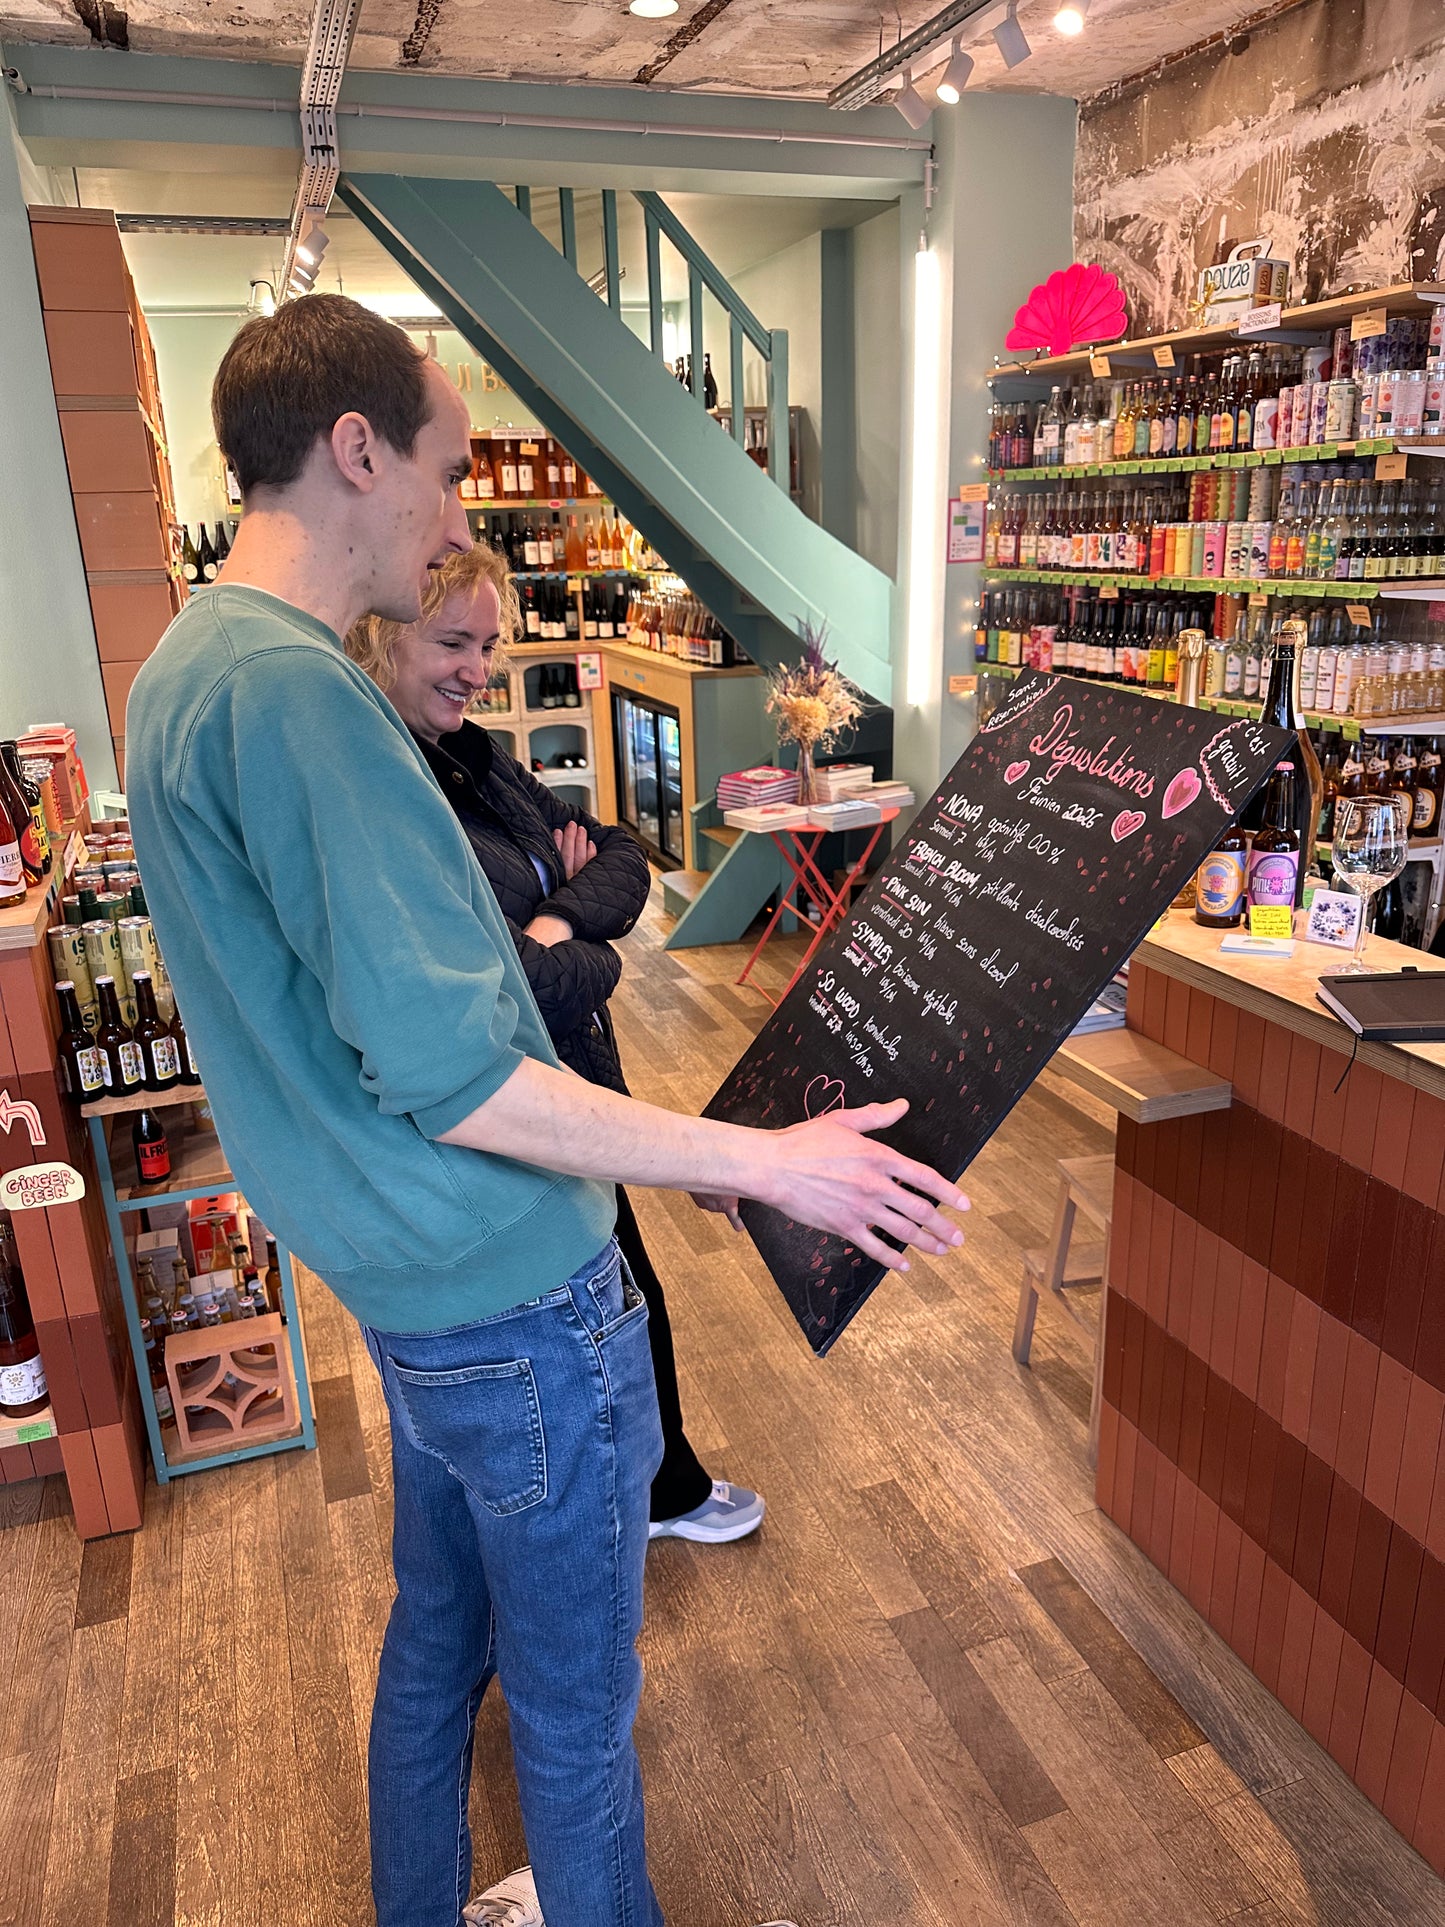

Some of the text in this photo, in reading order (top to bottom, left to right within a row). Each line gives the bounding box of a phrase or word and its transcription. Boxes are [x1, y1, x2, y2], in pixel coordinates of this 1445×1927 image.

[1008, 677, 1037, 702] Sans
[988, 689, 1043, 729] Réservation
[1029, 704, 1156, 799] Dégustations
[1245, 726, 1271, 756] c'est
[1208, 739, 1246, 781] gratuit
[1061, 804, 1103, 828] 2026
[953, 832, 968, 846] 7
[986, 818, 1030, 853] apéritifs
[911, 840, 946, 869] FRENCH
[1025, 900, 1084, 951] désalcoolisés
[1252, 876, 1270, 893] PINK
[898, 920, 912, 938] 20
[955, 937, 978, 959] sans
[980, 948, 1019, 988] alcool
[818, 970, 835, 992] SO
[6, 1169, 75, 1194] GINGER
[21, 1184, 69, 1206] BEER
